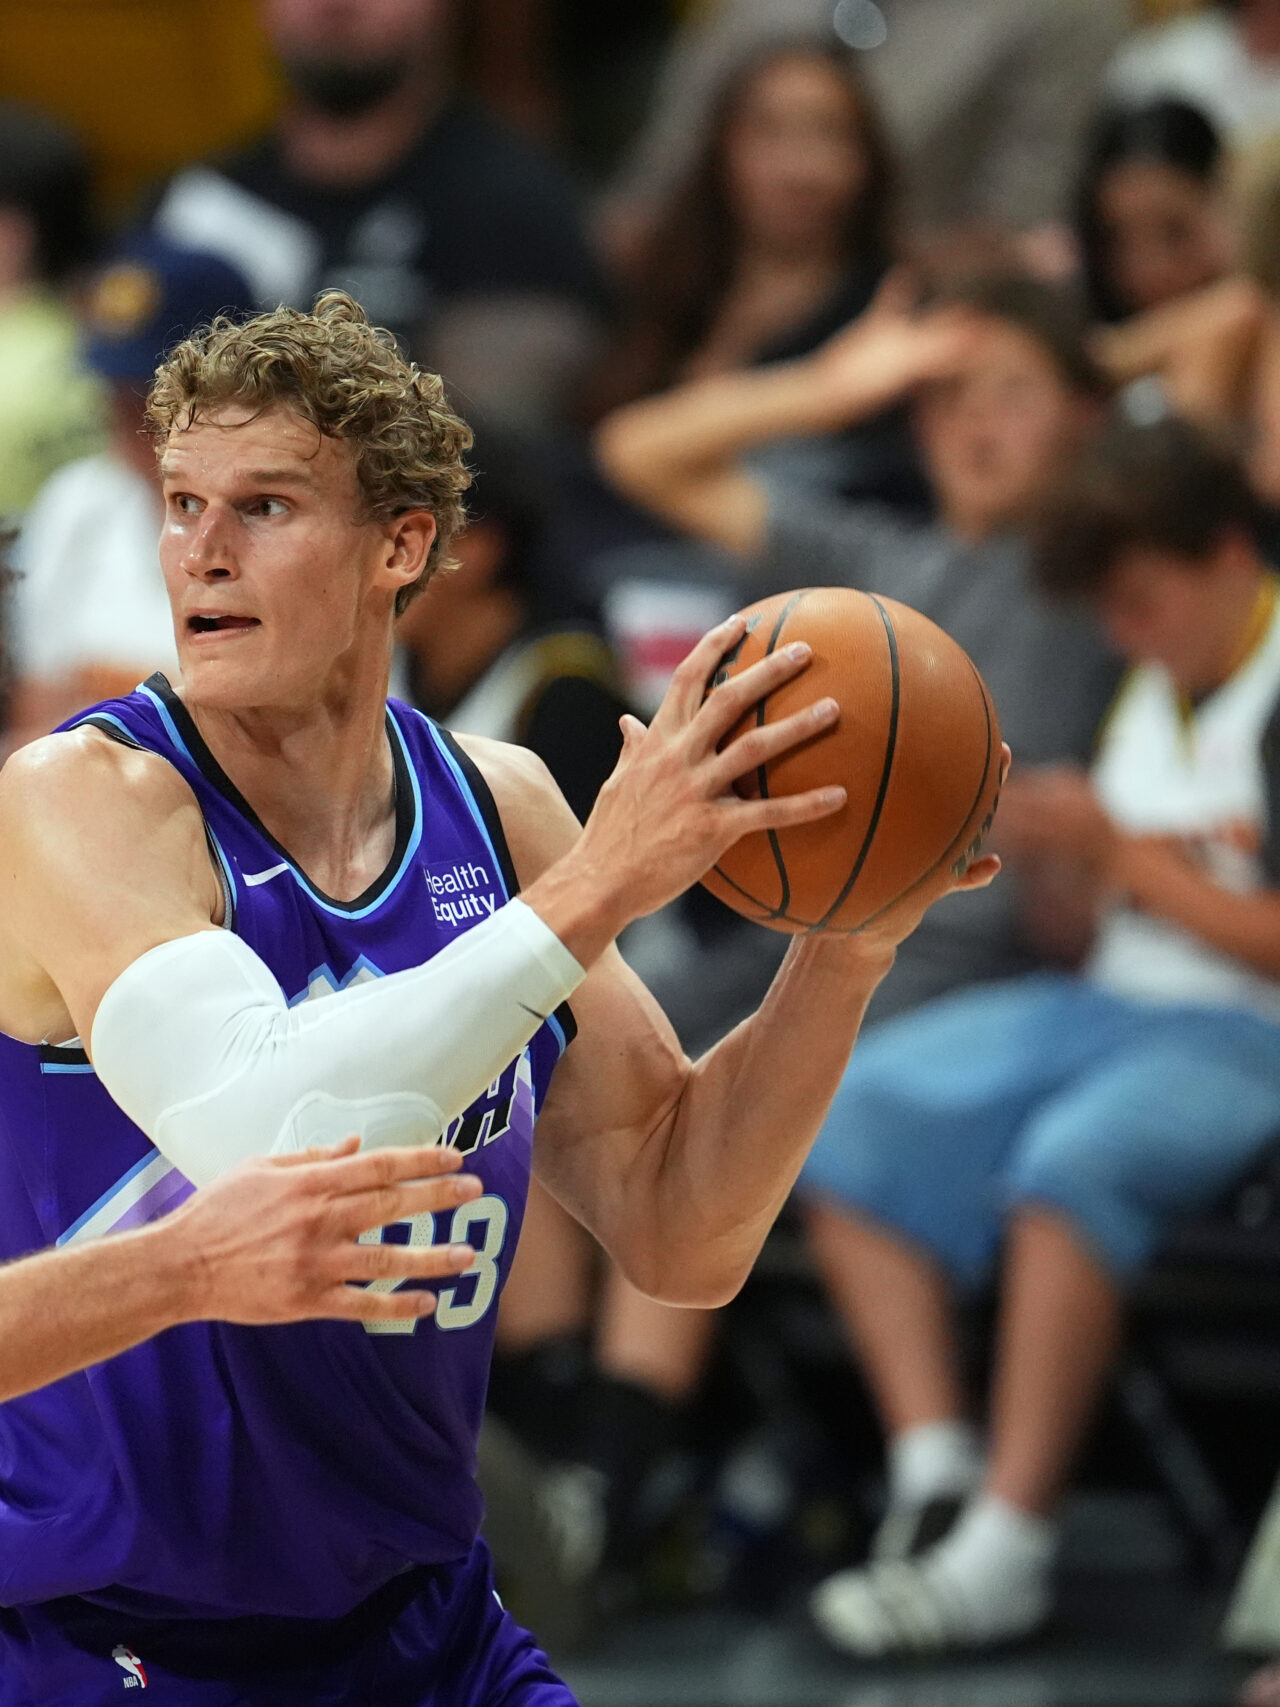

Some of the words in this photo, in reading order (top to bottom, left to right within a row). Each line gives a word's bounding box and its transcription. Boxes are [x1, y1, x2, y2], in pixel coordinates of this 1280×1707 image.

[424, 862, 489, 895] Health
[431, 893, 495, 926] Equity
[123, 1675, 139, 1688] NBA
